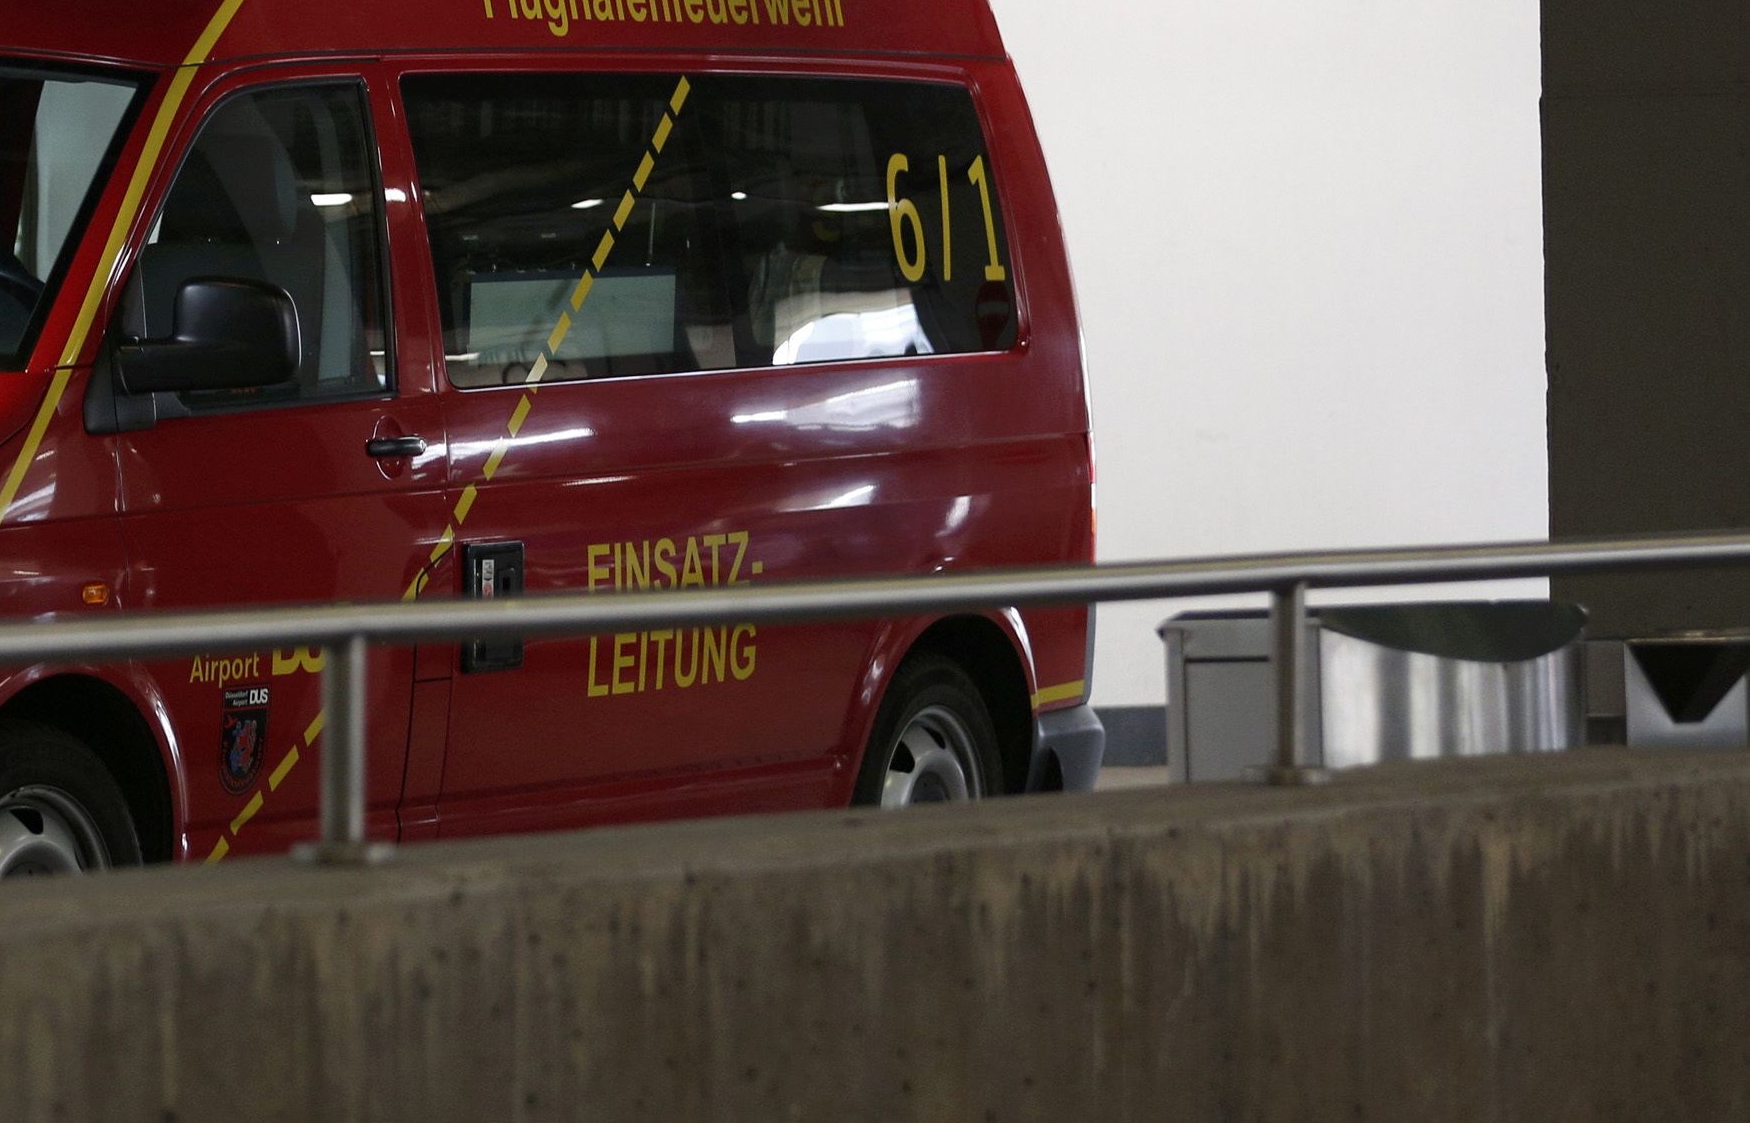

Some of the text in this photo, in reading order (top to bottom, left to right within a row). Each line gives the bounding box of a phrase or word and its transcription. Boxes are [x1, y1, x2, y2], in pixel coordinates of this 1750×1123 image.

[886, 152, 1006, 282] 6/1
[189, 651, 260, 689] Airport
[587, 623, 757, 698] LEITUNG
[249, 688, 269, 705] DUS
